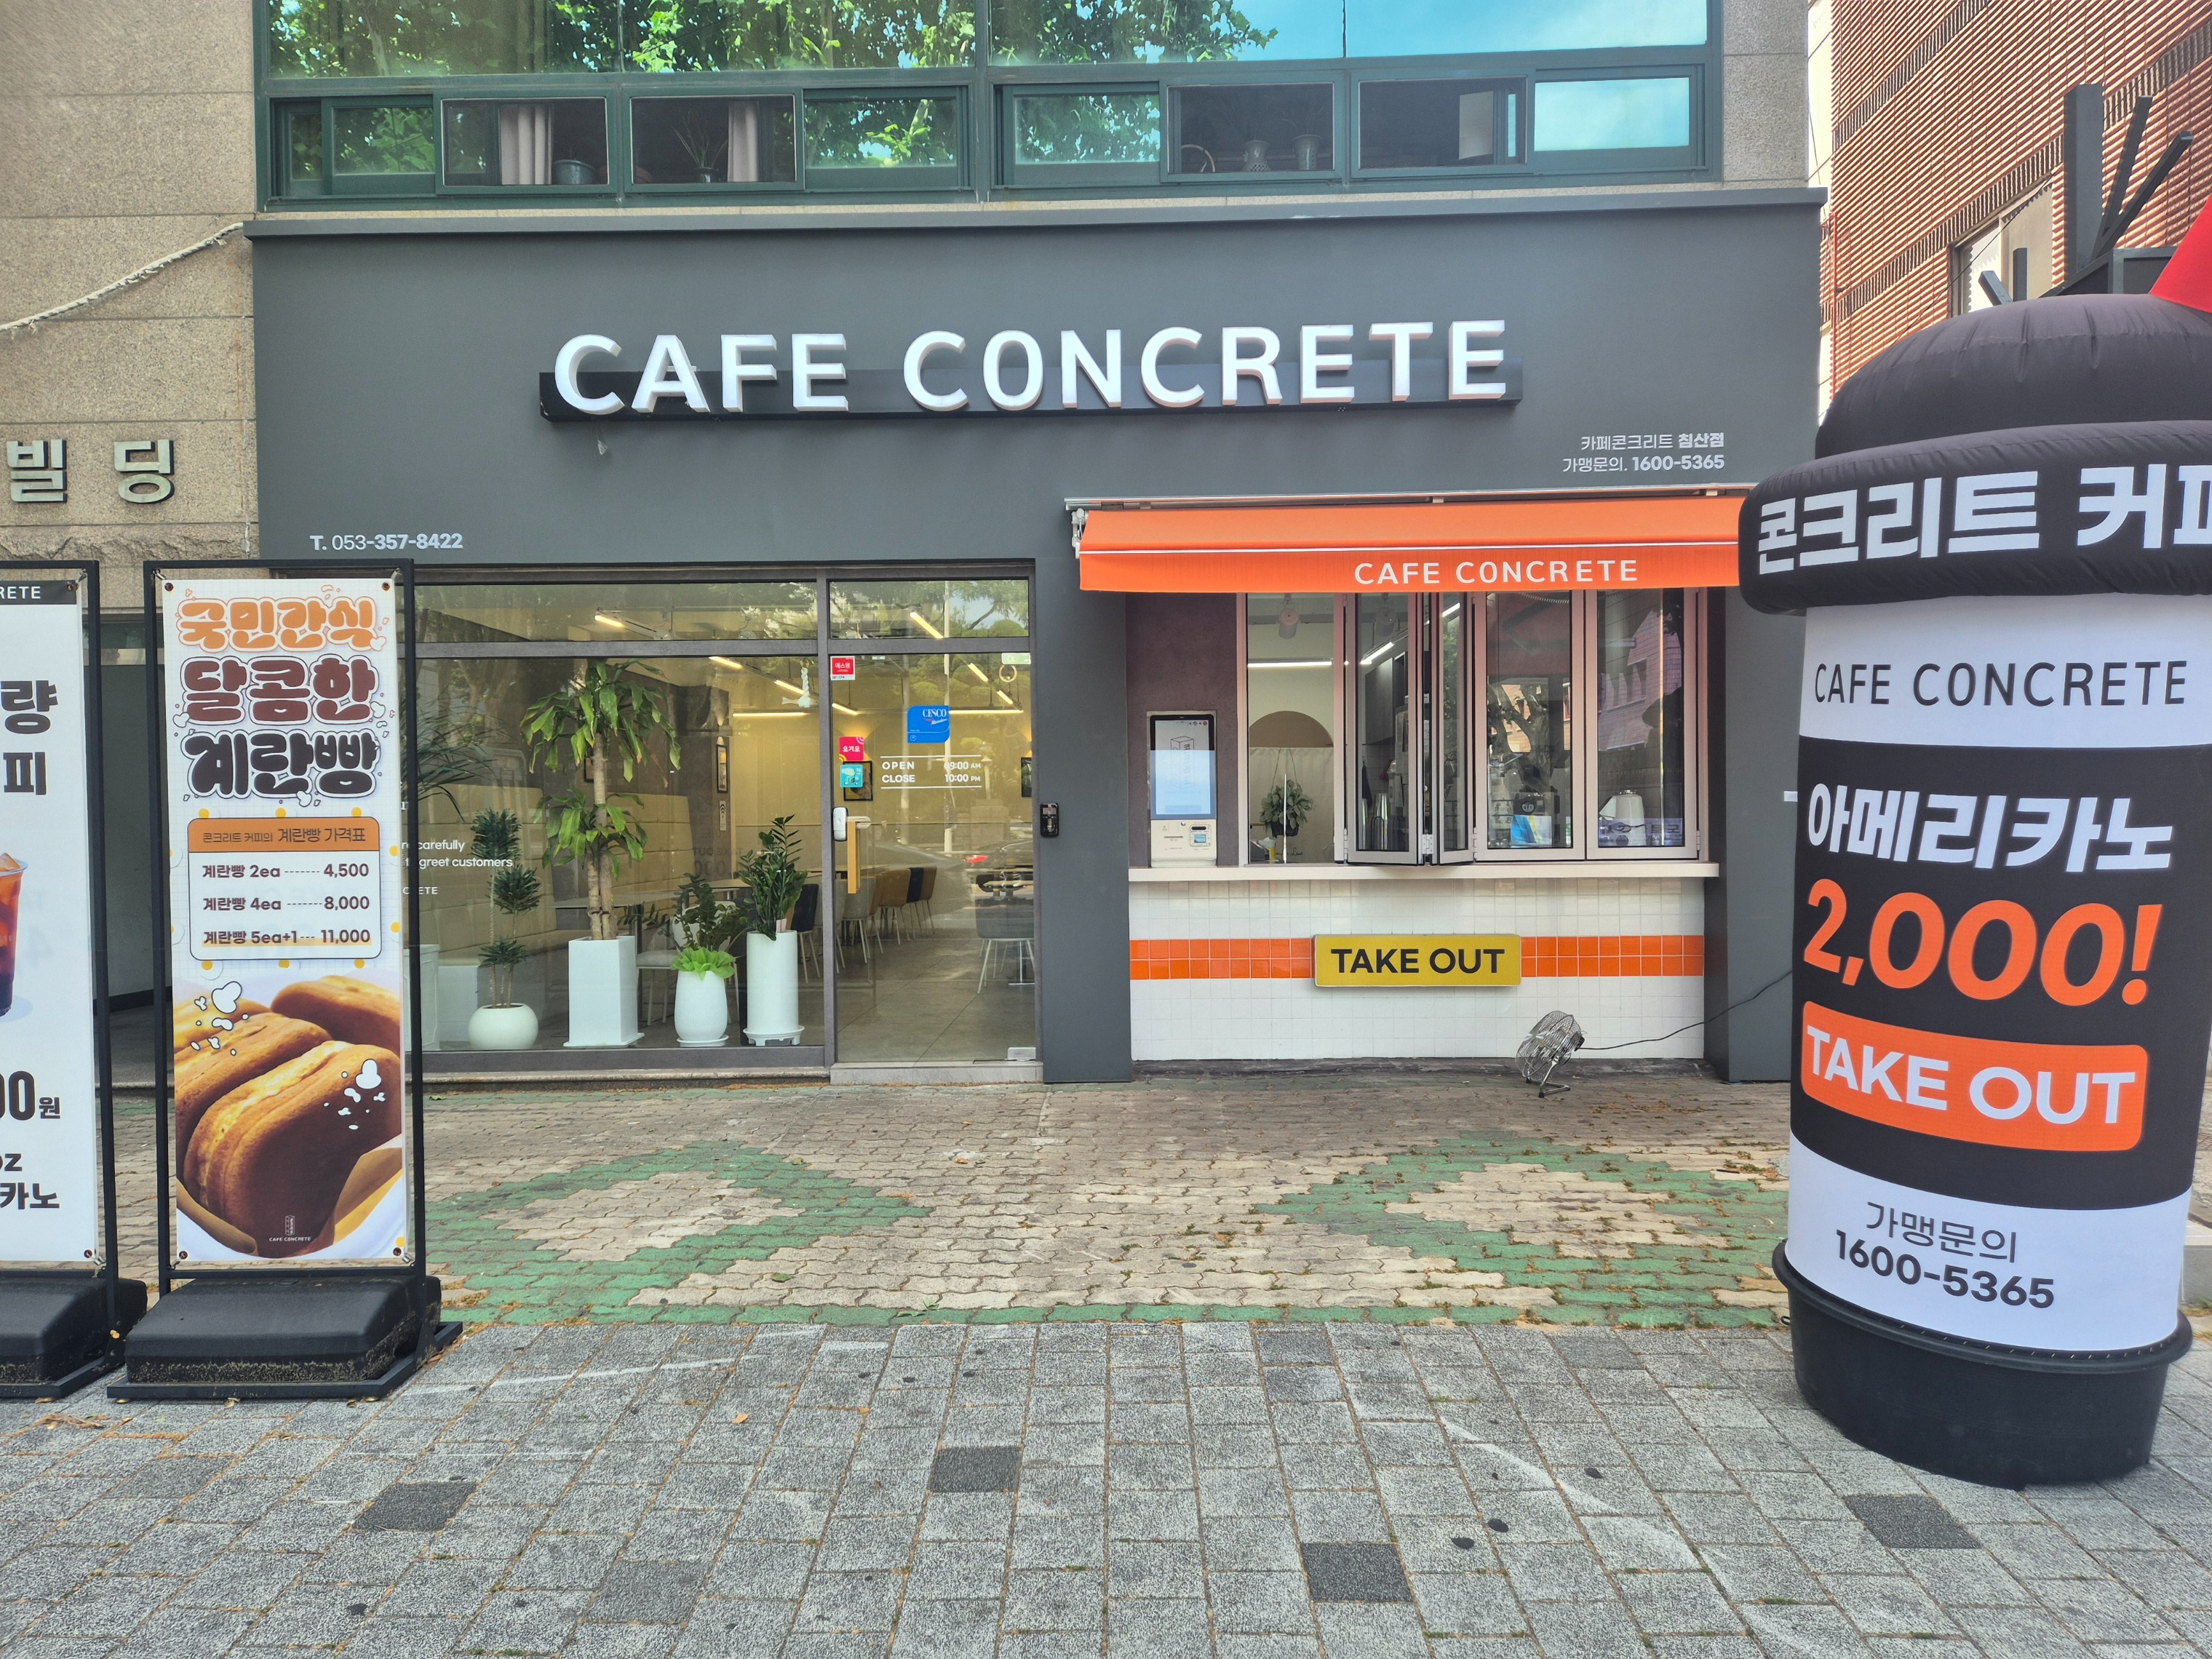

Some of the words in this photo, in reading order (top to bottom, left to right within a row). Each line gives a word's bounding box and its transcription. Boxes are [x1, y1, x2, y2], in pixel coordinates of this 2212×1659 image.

[554, 333, 849, 415] CAFE
[903, 319, 1506, 411] CONCRETE
[1580, 434, 1673, 450] 카페콘크리트
[1678, 432, 1724, 449] 침산점
[7, 438, 175, 504] 빌딩
[1562, 456, 1628, 473] 가맹문의.
[1632, 454, 1724, 472] 1600-5365
[1758, 470, 2040, 575] 콘크리트
[309, 535, 327, 551] T.
[332, 533, 464, 551] 053-357-8422
[1354, 561, 1441, 586] CAFE
[1455, 559, 1638, 585] CONCRETE
[179, 598, 376, 651] 국민간식
[182, 656, 378, 724] 달콤한
[1815, 664, 1891, 706] CAFE
[1913, 660, 2187, 707] CONCRETE
[922, 708, 947, 717] CESCO
[3, 752, 47, 796] 피
[182, 731, 380, 797] 계란빵
[882, 761, 915, 770] OPEN
[944, 761, 968, 770] 09:00
[882, 774, 915, 783] CLOSE
[944, 774, 968, 782] 10:00
[203, 832, 242, 843] 콘크리트
[244, 832, 273, 843] 커피의
[278, 828, 321, 843] 계란빵
[324, 827, 366, 843] 가격표
[1807, 783, 2172, 872] 아메리카노
[418, 839, 465, 852] carefully
[202, 864, 245, 878] 계란빵
[250, 864, 281, 878] 2ea
[323, 863, 369, 878] 4,500
[419, 857, 449, 870] greet
[451, 858, 513, 867] customers
[203, 897, 246, 910] 계란빵
[250, 897, 282, 910] 4ea
[324, 896, 370, 911] 8,000
[204, 931, 247, 944] 계란빵
[251, 931, 297, 944] 5ea+1
[321, 929, 370, 944] 11,000
[1803, 878, 2163, 1006] 2,000!
[1330, 948, 1420, 974] TAKE
[1428, 948, 1505, 974] OUT
[1807, 1025, 1949, 1111] TAKE
[1969, 1066, 2136, 1124] OUT
[0, 1070, 60, 1121] 0원
[1866, 1201, 2016, 1263] 가맹문의
[1836, 1229, 2055, 1309] 1600-5365
